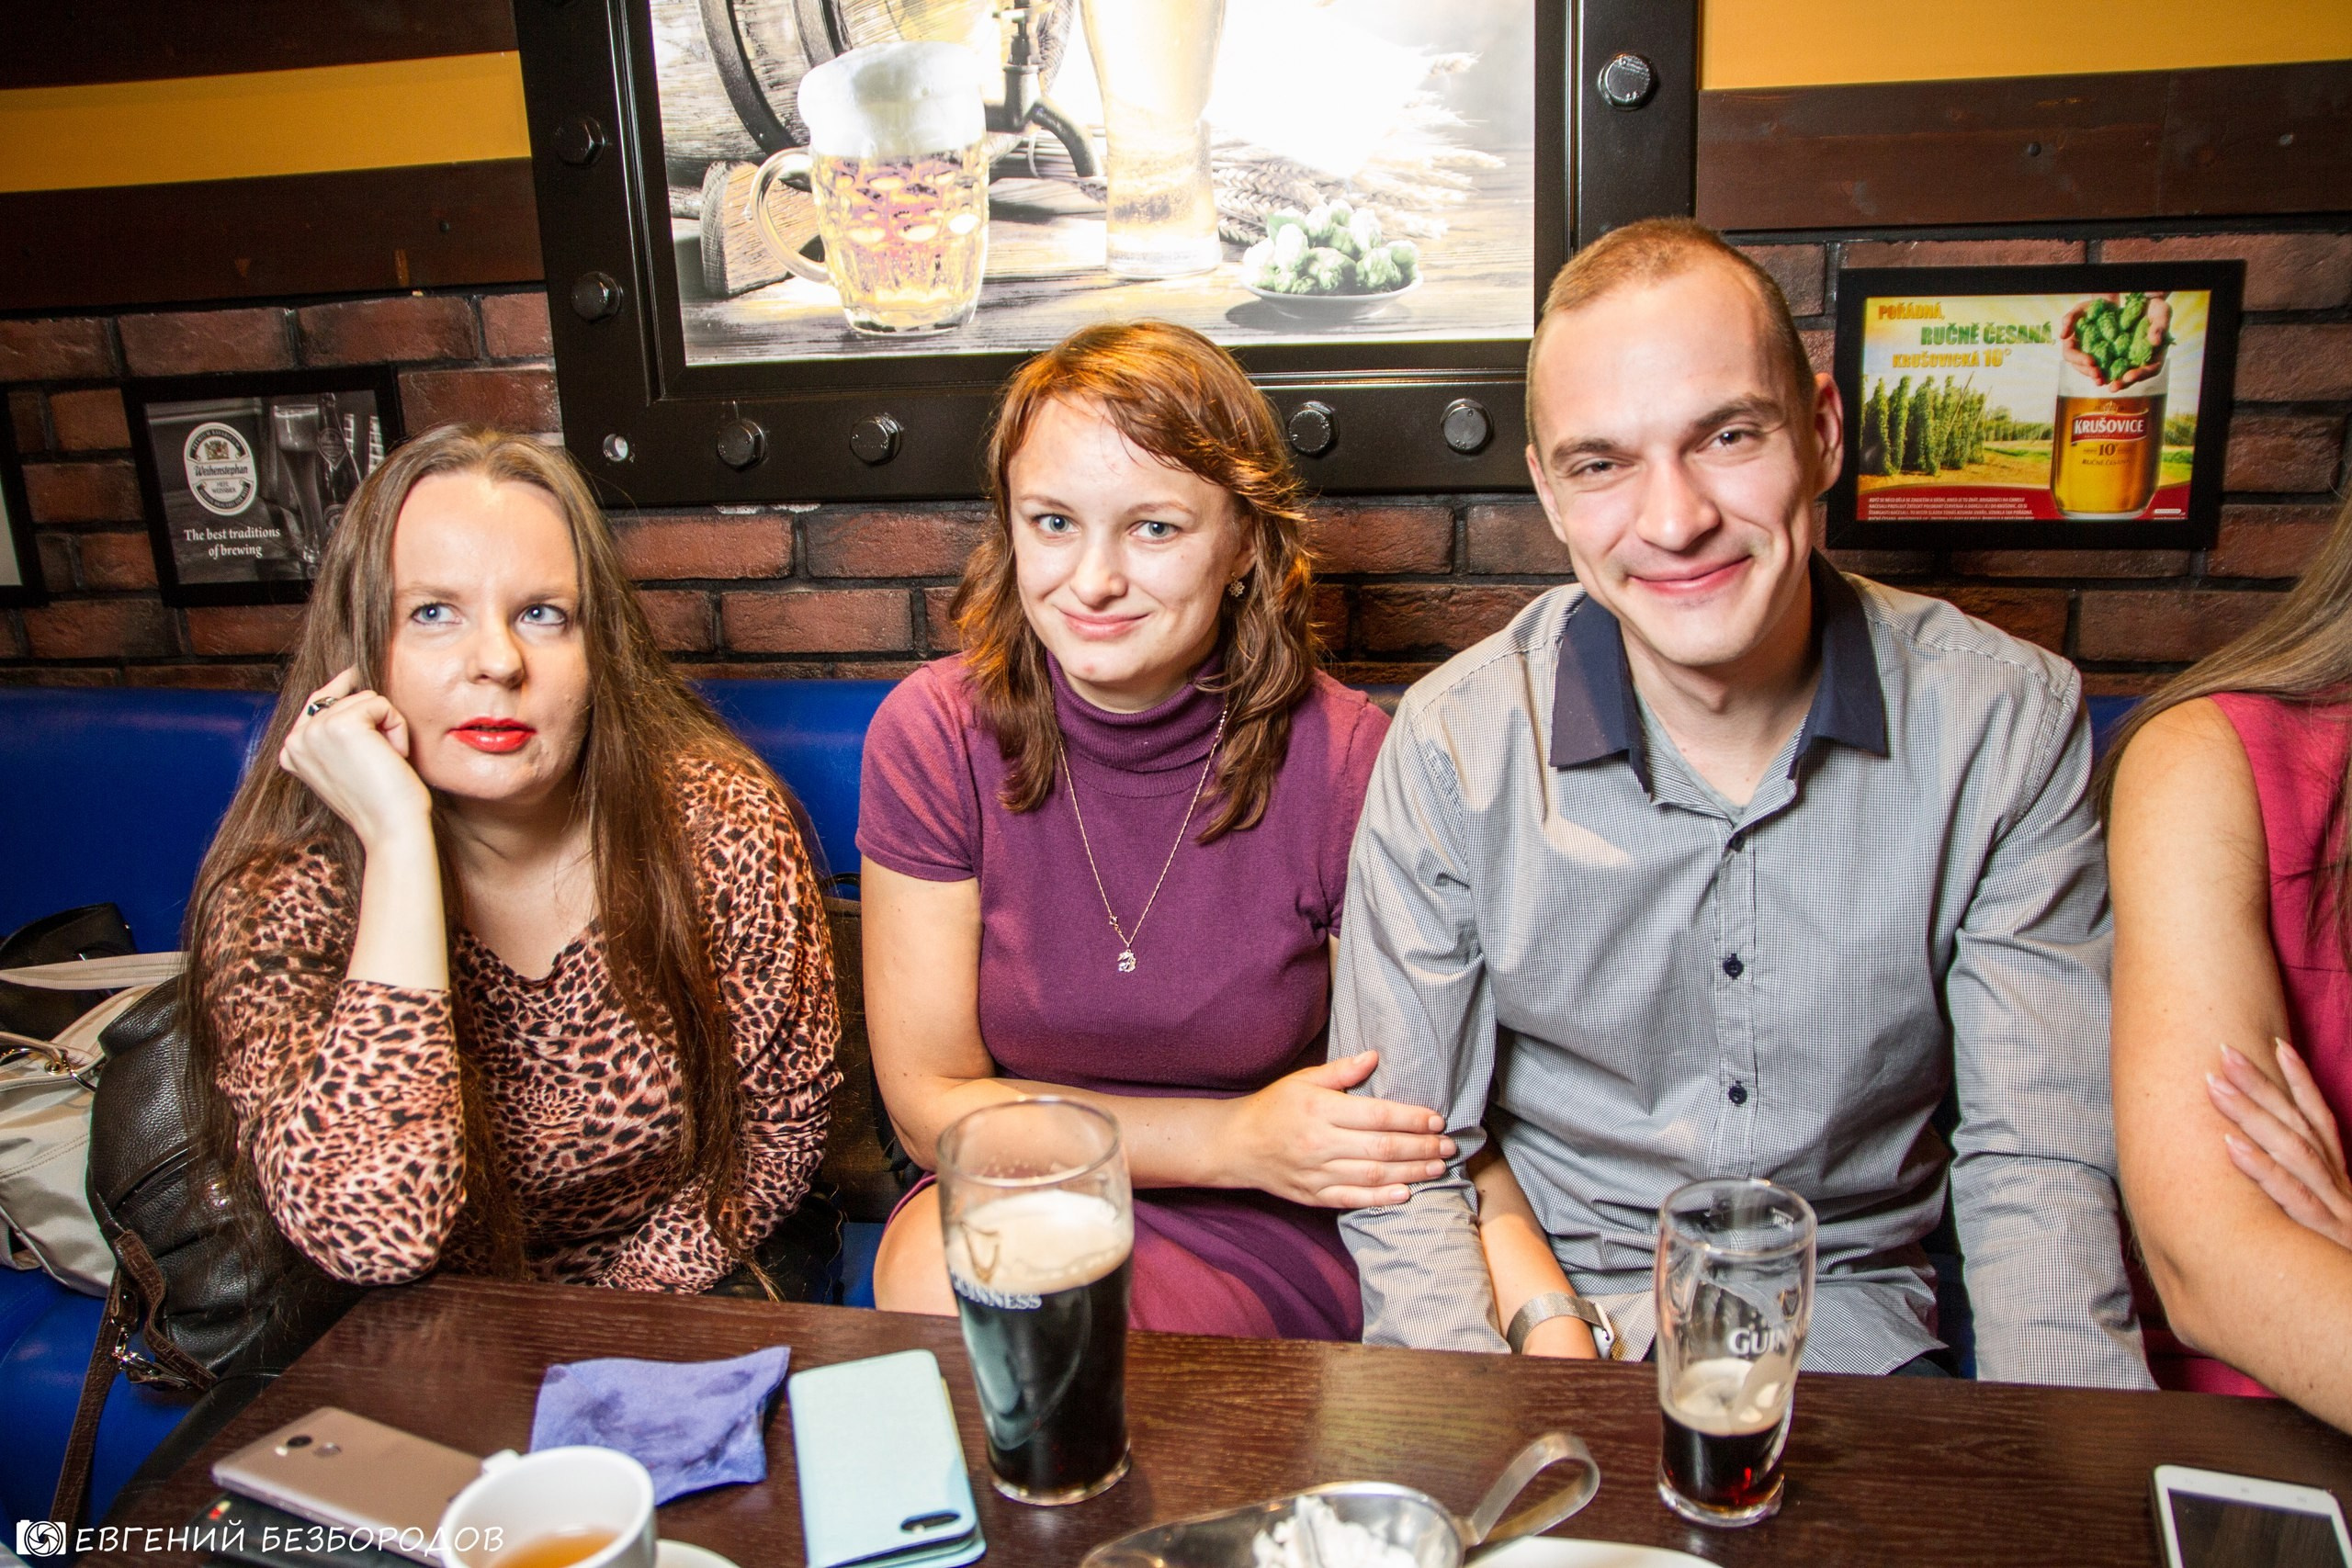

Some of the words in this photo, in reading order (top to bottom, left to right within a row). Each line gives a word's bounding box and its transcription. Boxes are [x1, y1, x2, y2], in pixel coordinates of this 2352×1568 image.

[1879, 301, 1945, 320] POŘÁDNÁ,
[1921, 322, 1979, 345] RUČNĚ
[1983, 321, 2056, 345] ČESANÁ,
[1893, 351, 1980, 367] KRUŠOVICKÁ
[1983, 348, 2012, 367] 10°
[2074, 417, 2143, 434] KRUŠOVICE
[194, 463, 248, 477] Weihenstephan
[184, 528, 204, 541] The
[206, 528, 227, 540] best
[229, 526, 281, 539] traditions
[208, 544, 220, 560] of
[220, 544, 263, 558] brewing
